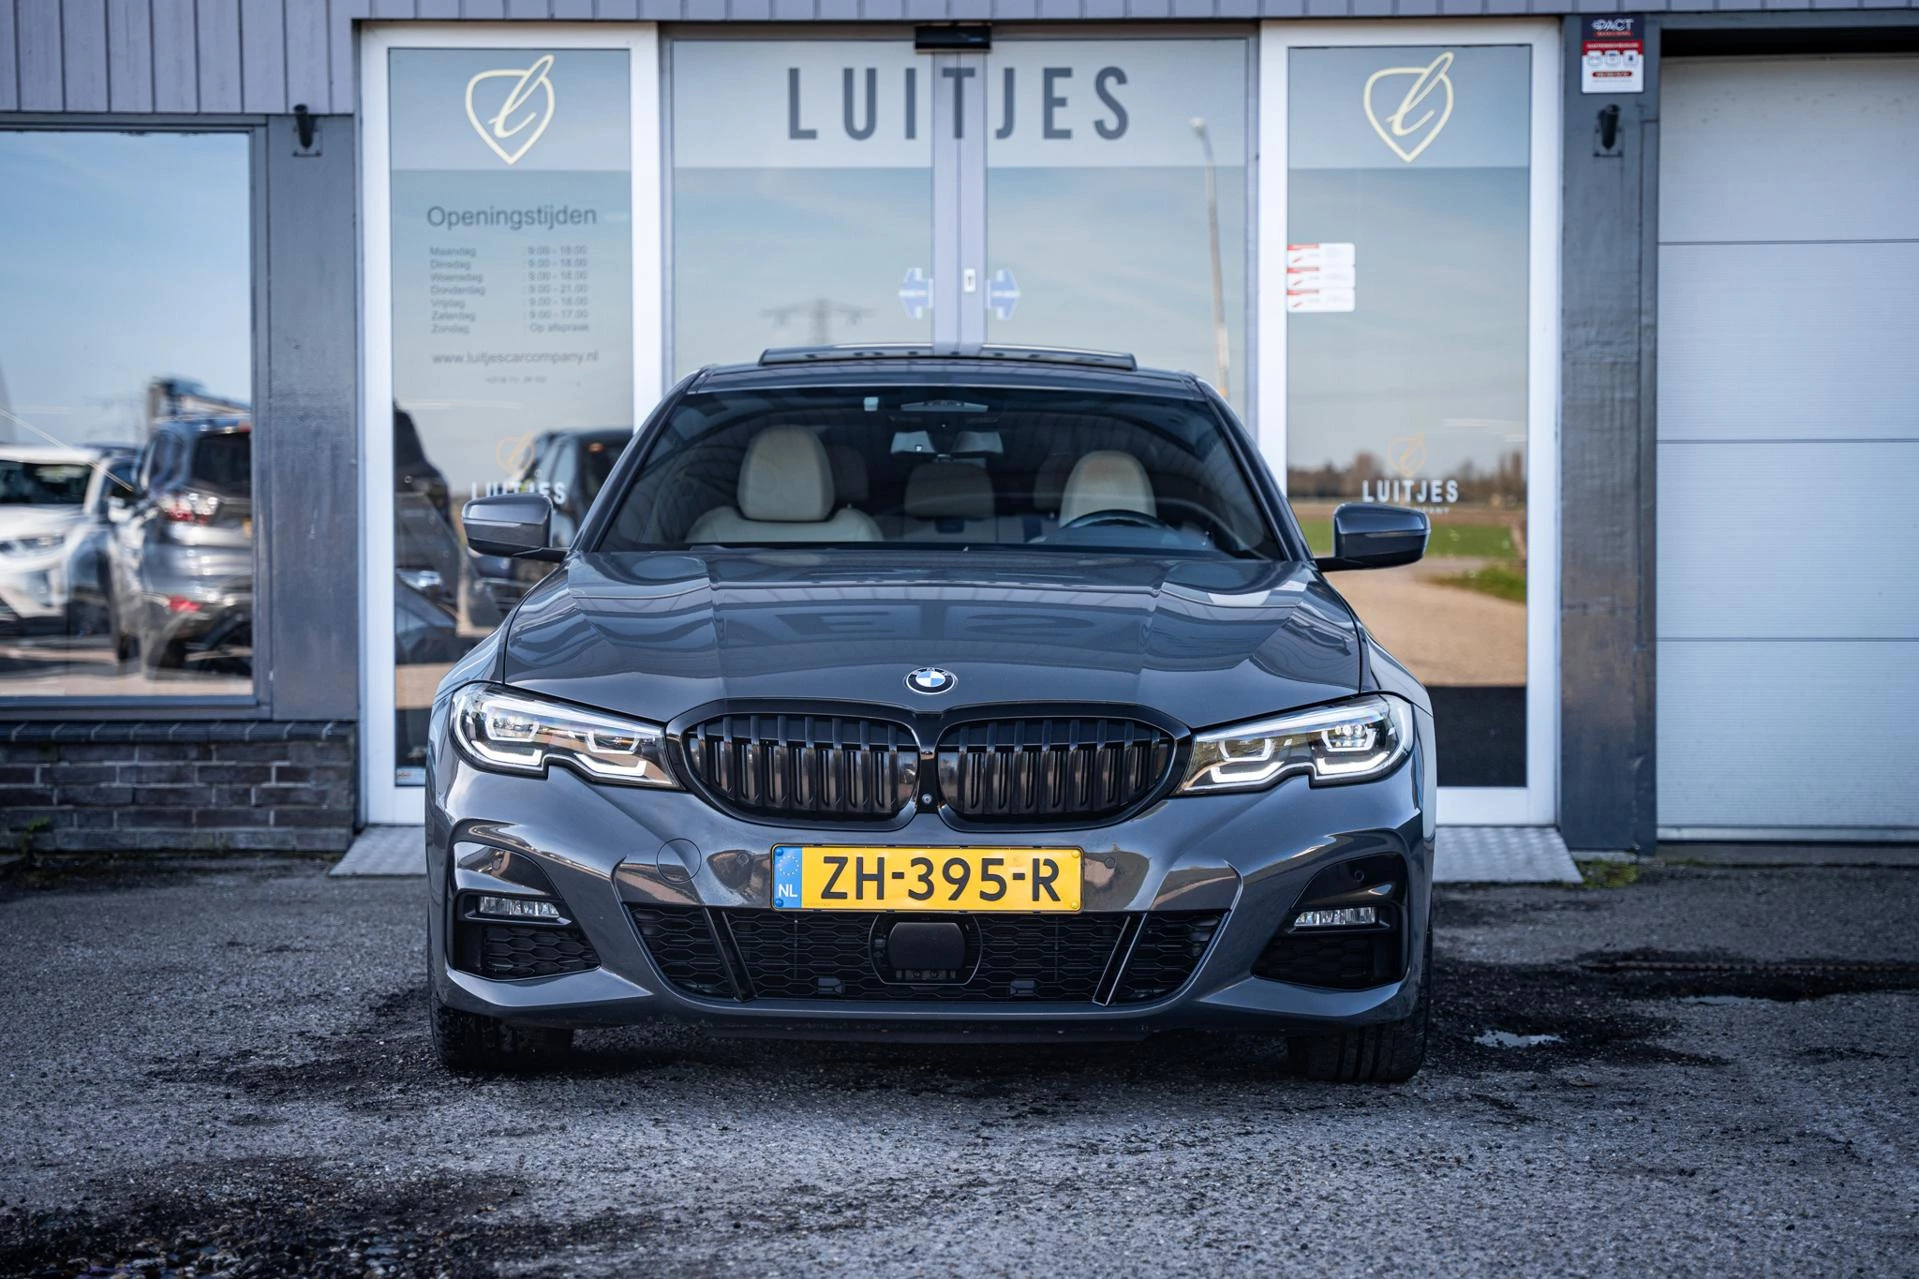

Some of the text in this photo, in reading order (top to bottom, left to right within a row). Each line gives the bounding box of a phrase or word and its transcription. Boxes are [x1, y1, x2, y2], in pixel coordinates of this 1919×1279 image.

[788, 66, 1129, 140] LUITJES
[427, 205, 598, 231] Openingstijden
[429, 246, 477, 257] Maandag
[430, 285, 486, 296] Donderdag
[529, 323, 545, 333] Op
[1362, 480, 1458, 503] LUITJES
[821, 856, 1061, 901] ZH-395-R
[778, 884, 798, 897] NL
